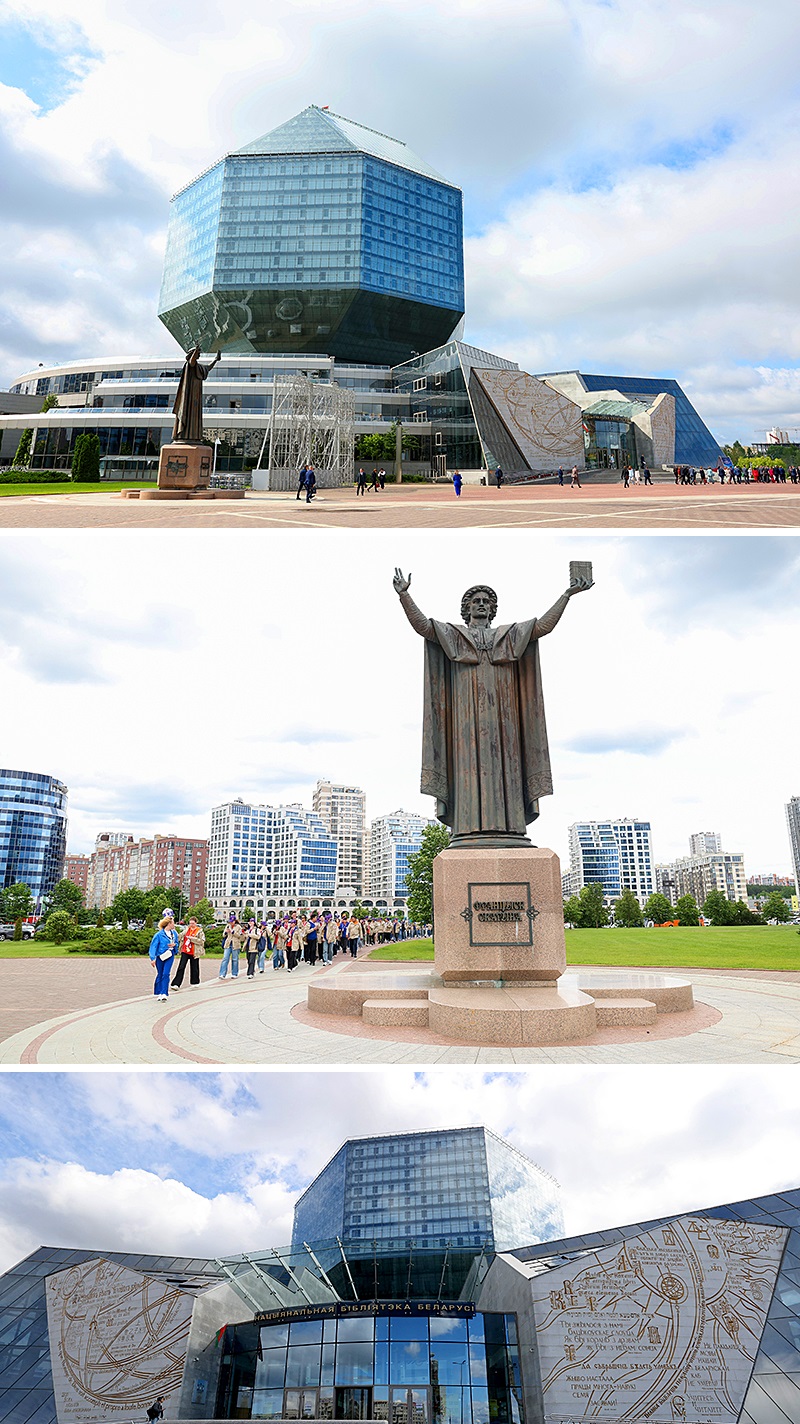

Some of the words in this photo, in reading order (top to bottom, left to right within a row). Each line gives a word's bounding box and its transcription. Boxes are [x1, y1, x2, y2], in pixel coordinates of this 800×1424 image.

[254, 1306, 335, 1321] НАЦЫЯНАЛЬНАЯ
[340, 1303, 411, 1312] БІБЛІЯТЭКА
[417, 1303, 475, 1312] БЕЛАРУСІ
